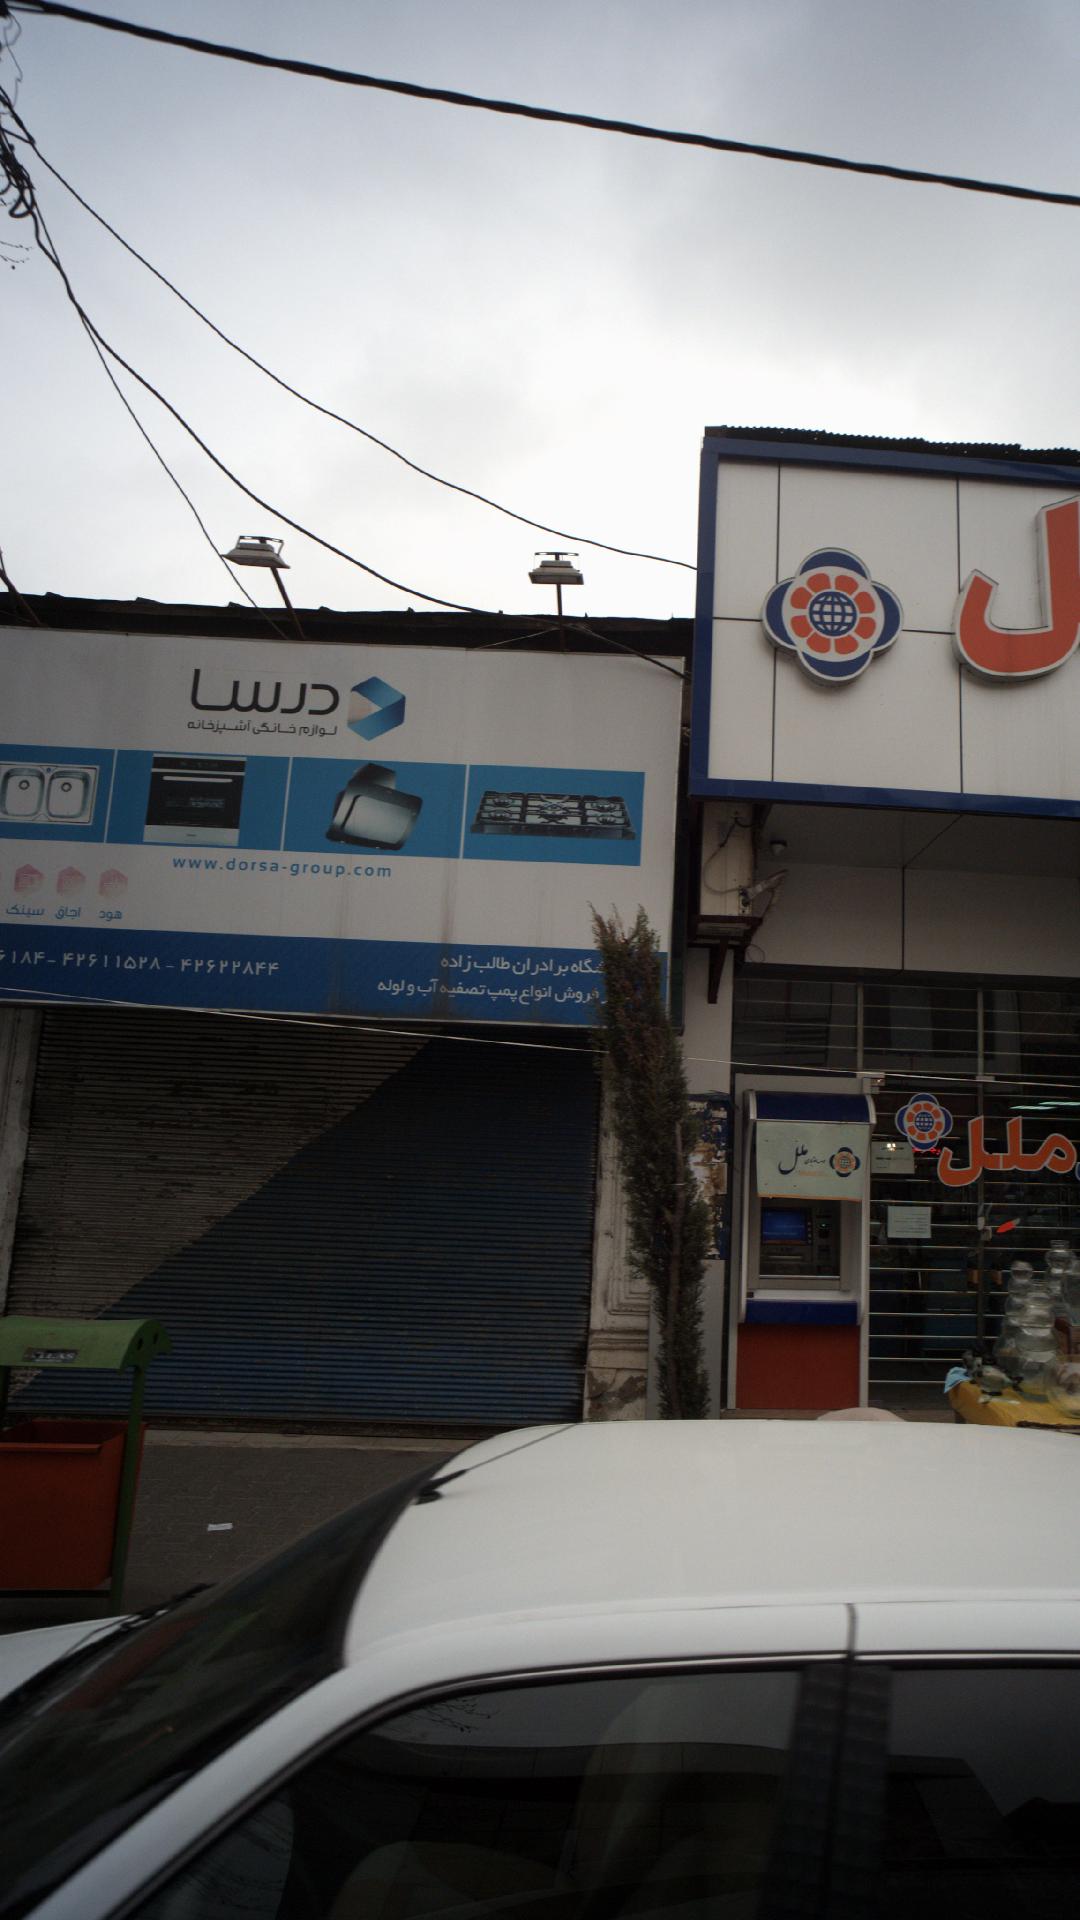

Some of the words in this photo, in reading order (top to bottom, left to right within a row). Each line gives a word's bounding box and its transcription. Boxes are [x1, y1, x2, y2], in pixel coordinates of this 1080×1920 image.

[190, 668, 340, 716] درسا
[187, 719, 251, 733] آشپزخانه
[252, 721, 297, 736] خانگی
[298, 723, 338, 738] لوازم
[172, 856, 393, 879] www.dorsa-group.com
[55, 906, 81, 920] اجاق
[98, 908, 123, 922] هود
[377, 979, 405, 996] لوله
[417, 978, 439, 998] آب
[440, 983, 486, 998] تصفیه
[487, 989, 518, 1003] پمپ
[518, 986, 553, 1005] انواع
[937, 1115, 1077, 1187] ملل
